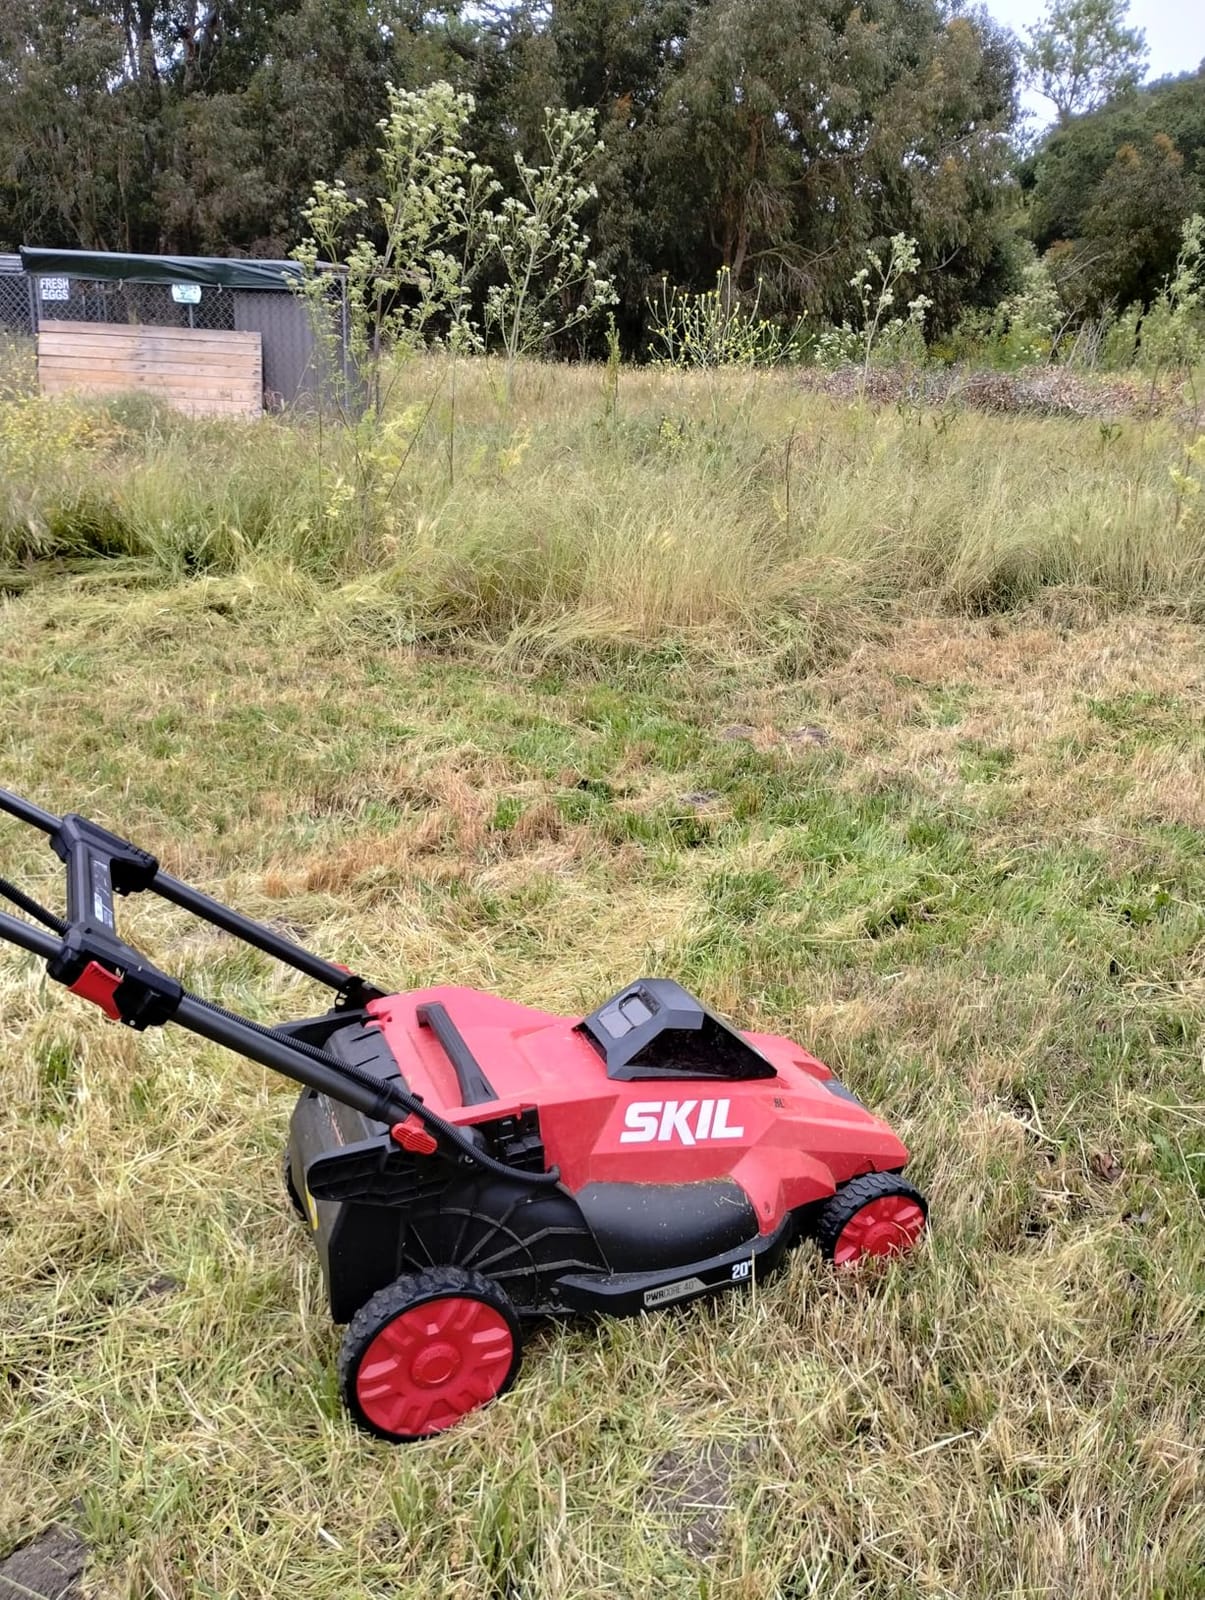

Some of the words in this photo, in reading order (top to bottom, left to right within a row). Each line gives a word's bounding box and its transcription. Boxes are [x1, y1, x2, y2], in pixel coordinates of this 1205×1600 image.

[40, 278, 69, 289] FRESH
[42, 289, 69, 300] EGGS
[620, 1099, 744, 1145] SKIL
